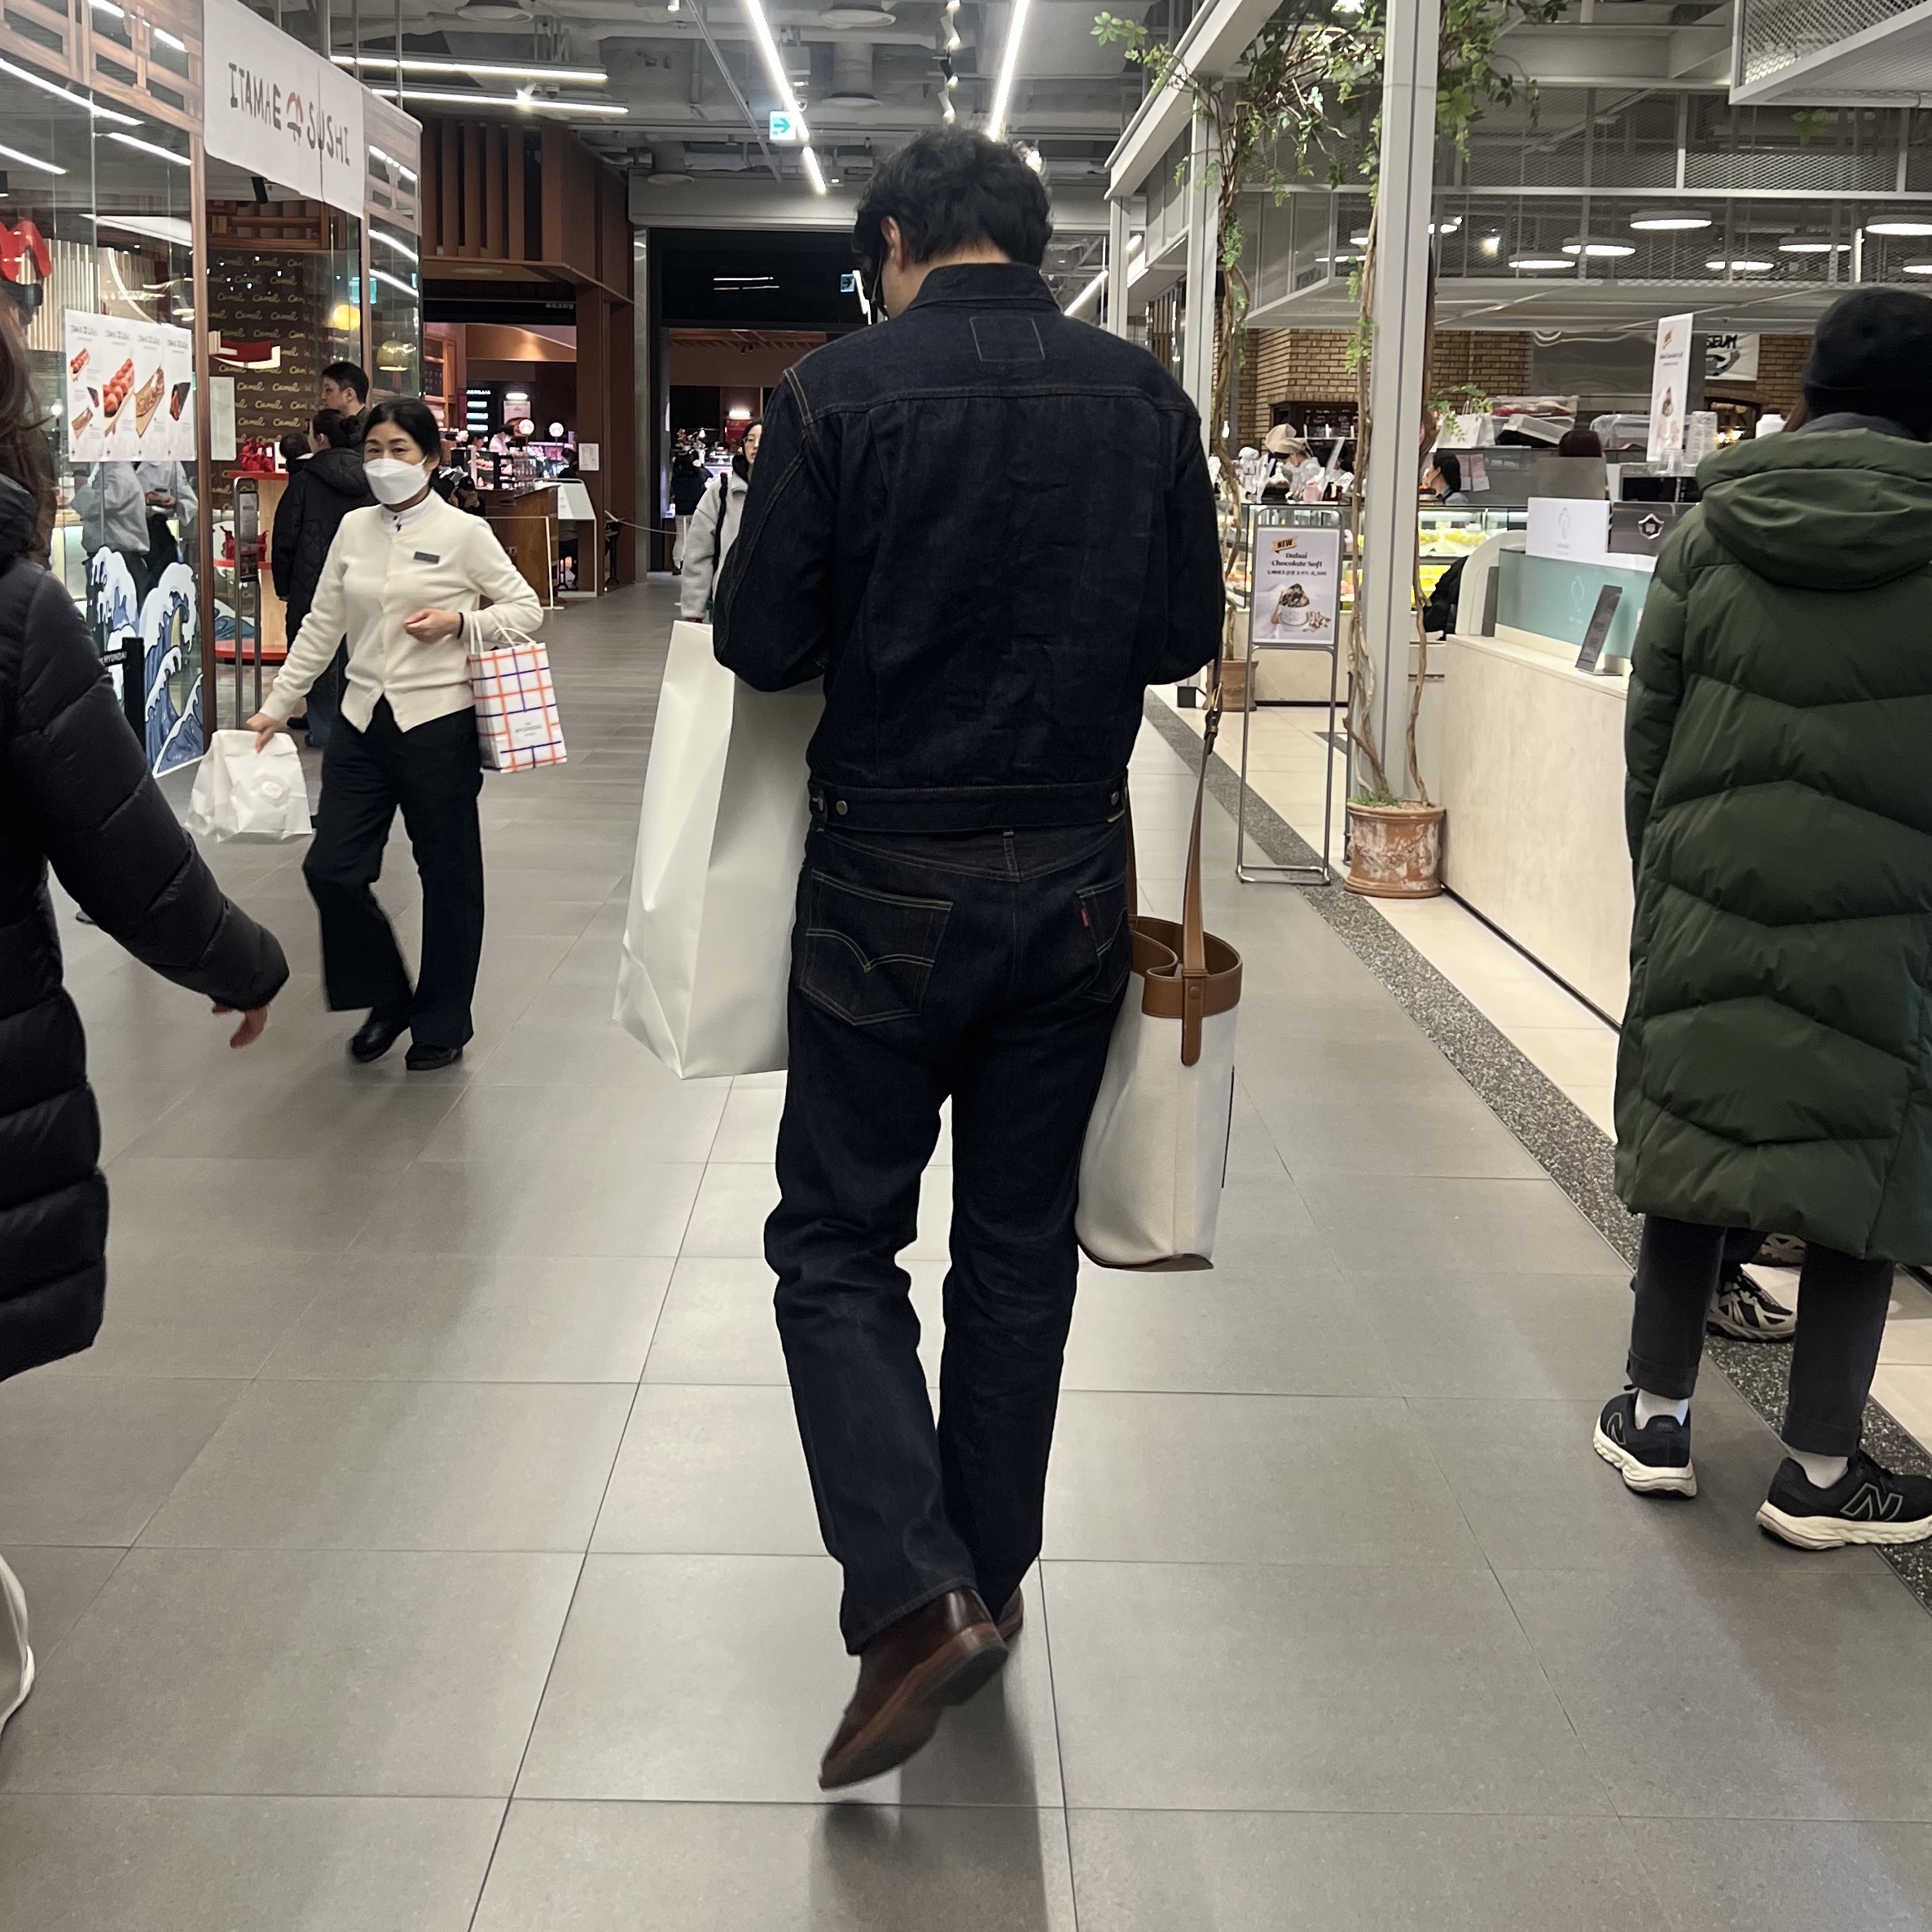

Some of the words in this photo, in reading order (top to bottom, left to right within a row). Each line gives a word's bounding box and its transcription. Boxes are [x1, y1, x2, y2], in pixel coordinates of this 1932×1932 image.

[228, 62, 282, 131] ITAMAE
[307, 100, 350, 166] SUSHI
[237, 381, 265, 391] Camel
[272, 382, 300, 393] Camel
[255, 400, 283, 410] Camel
[238, 417, 266, 427] Camel
[273, 418, 301, 428] Camel
